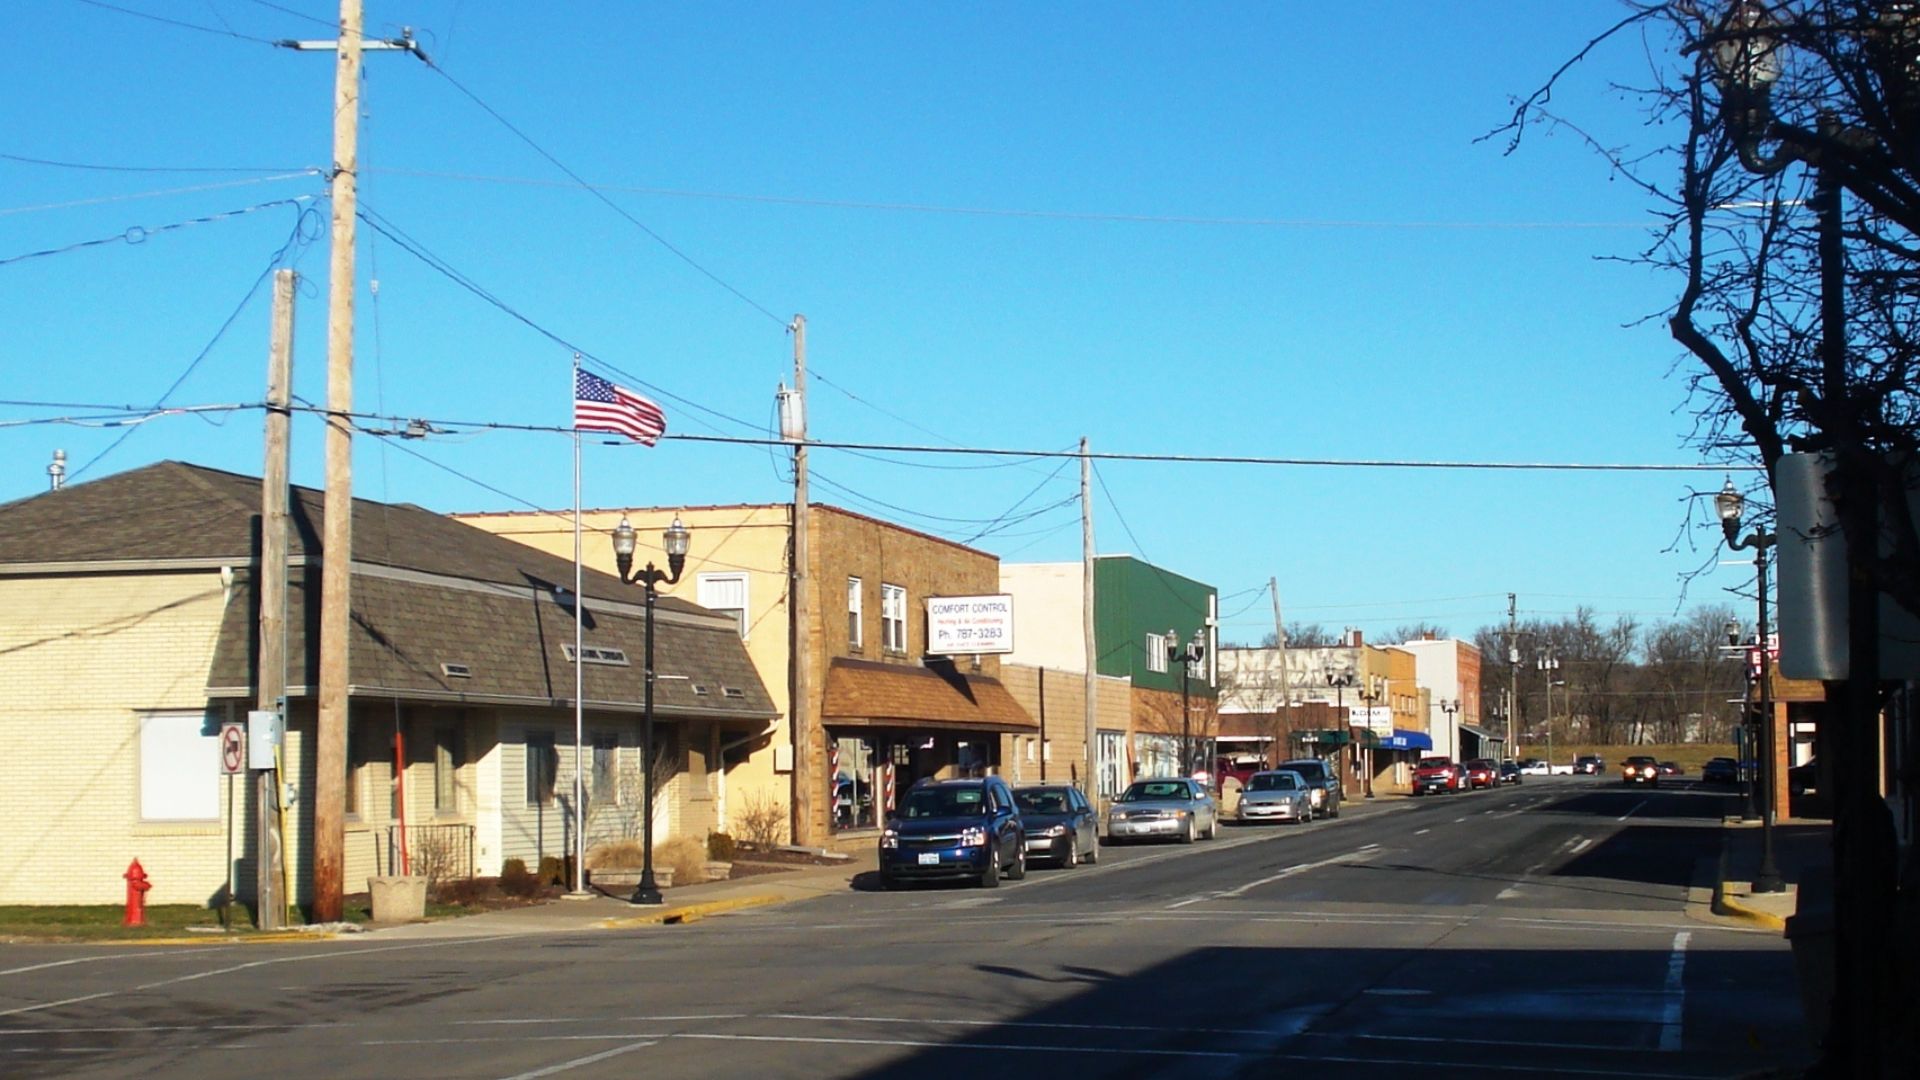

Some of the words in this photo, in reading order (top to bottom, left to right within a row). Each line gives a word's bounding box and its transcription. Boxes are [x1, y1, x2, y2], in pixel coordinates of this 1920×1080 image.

[932, 604, 969, 614] COMFORT
[972, 603, 1008, 613] CONTROL
[957, 628, 1003, 639] 787-3283
